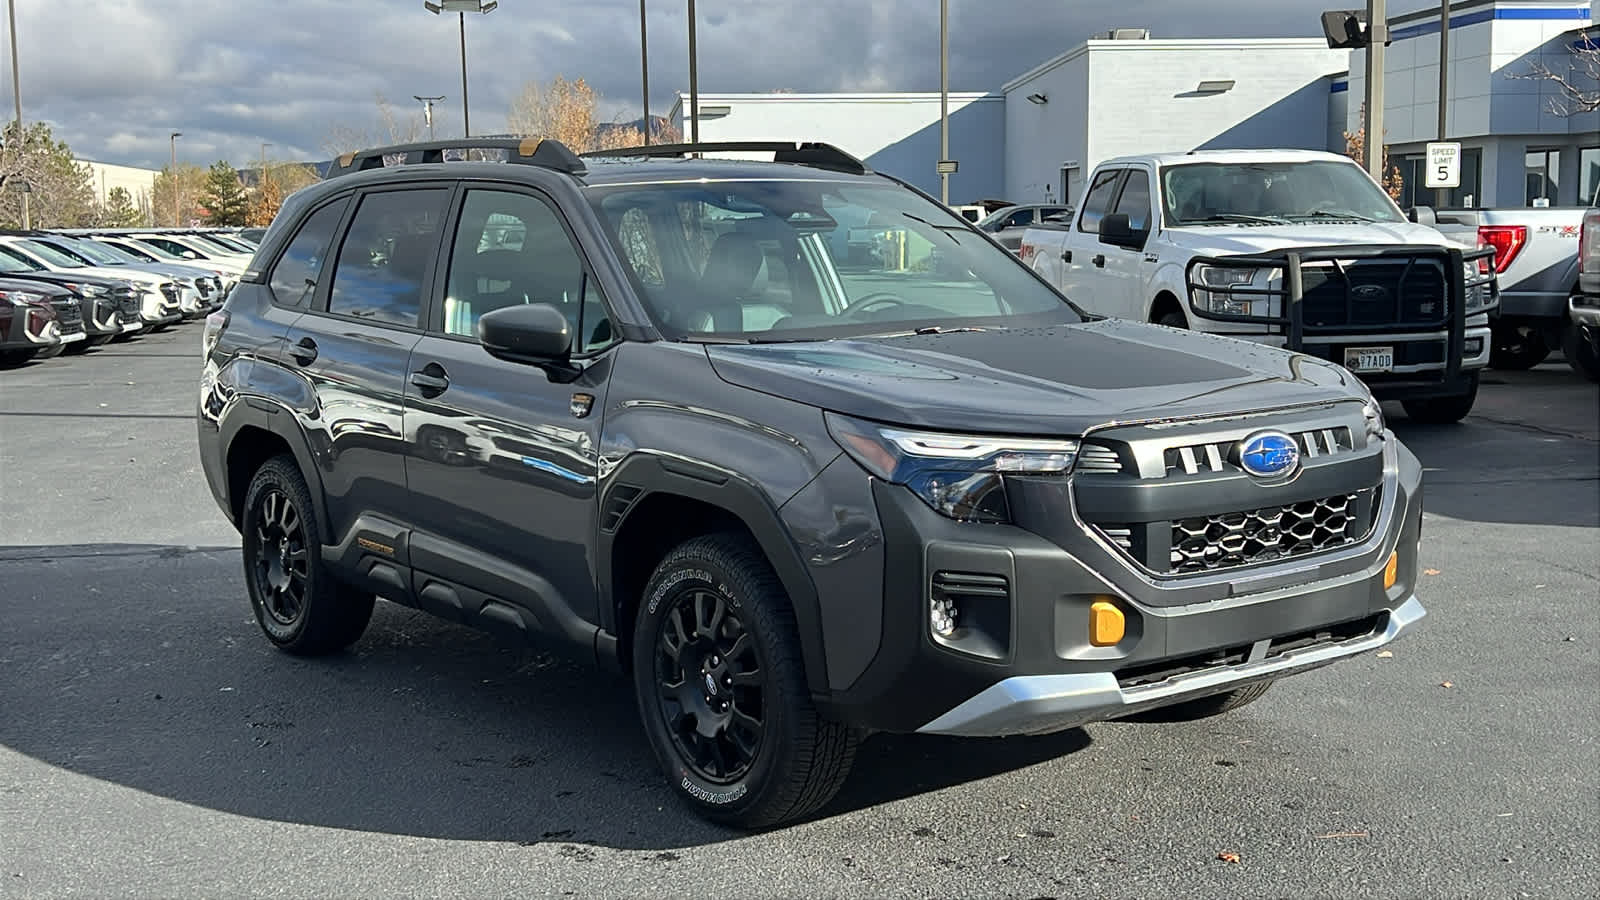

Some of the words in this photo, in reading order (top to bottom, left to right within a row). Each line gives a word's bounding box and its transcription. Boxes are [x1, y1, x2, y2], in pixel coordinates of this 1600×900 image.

[1431, 148, 1456, 156] SPEED
[1434, 157, 1453, 165] LIMIT
[1437, 166, 1449, 181] 5
